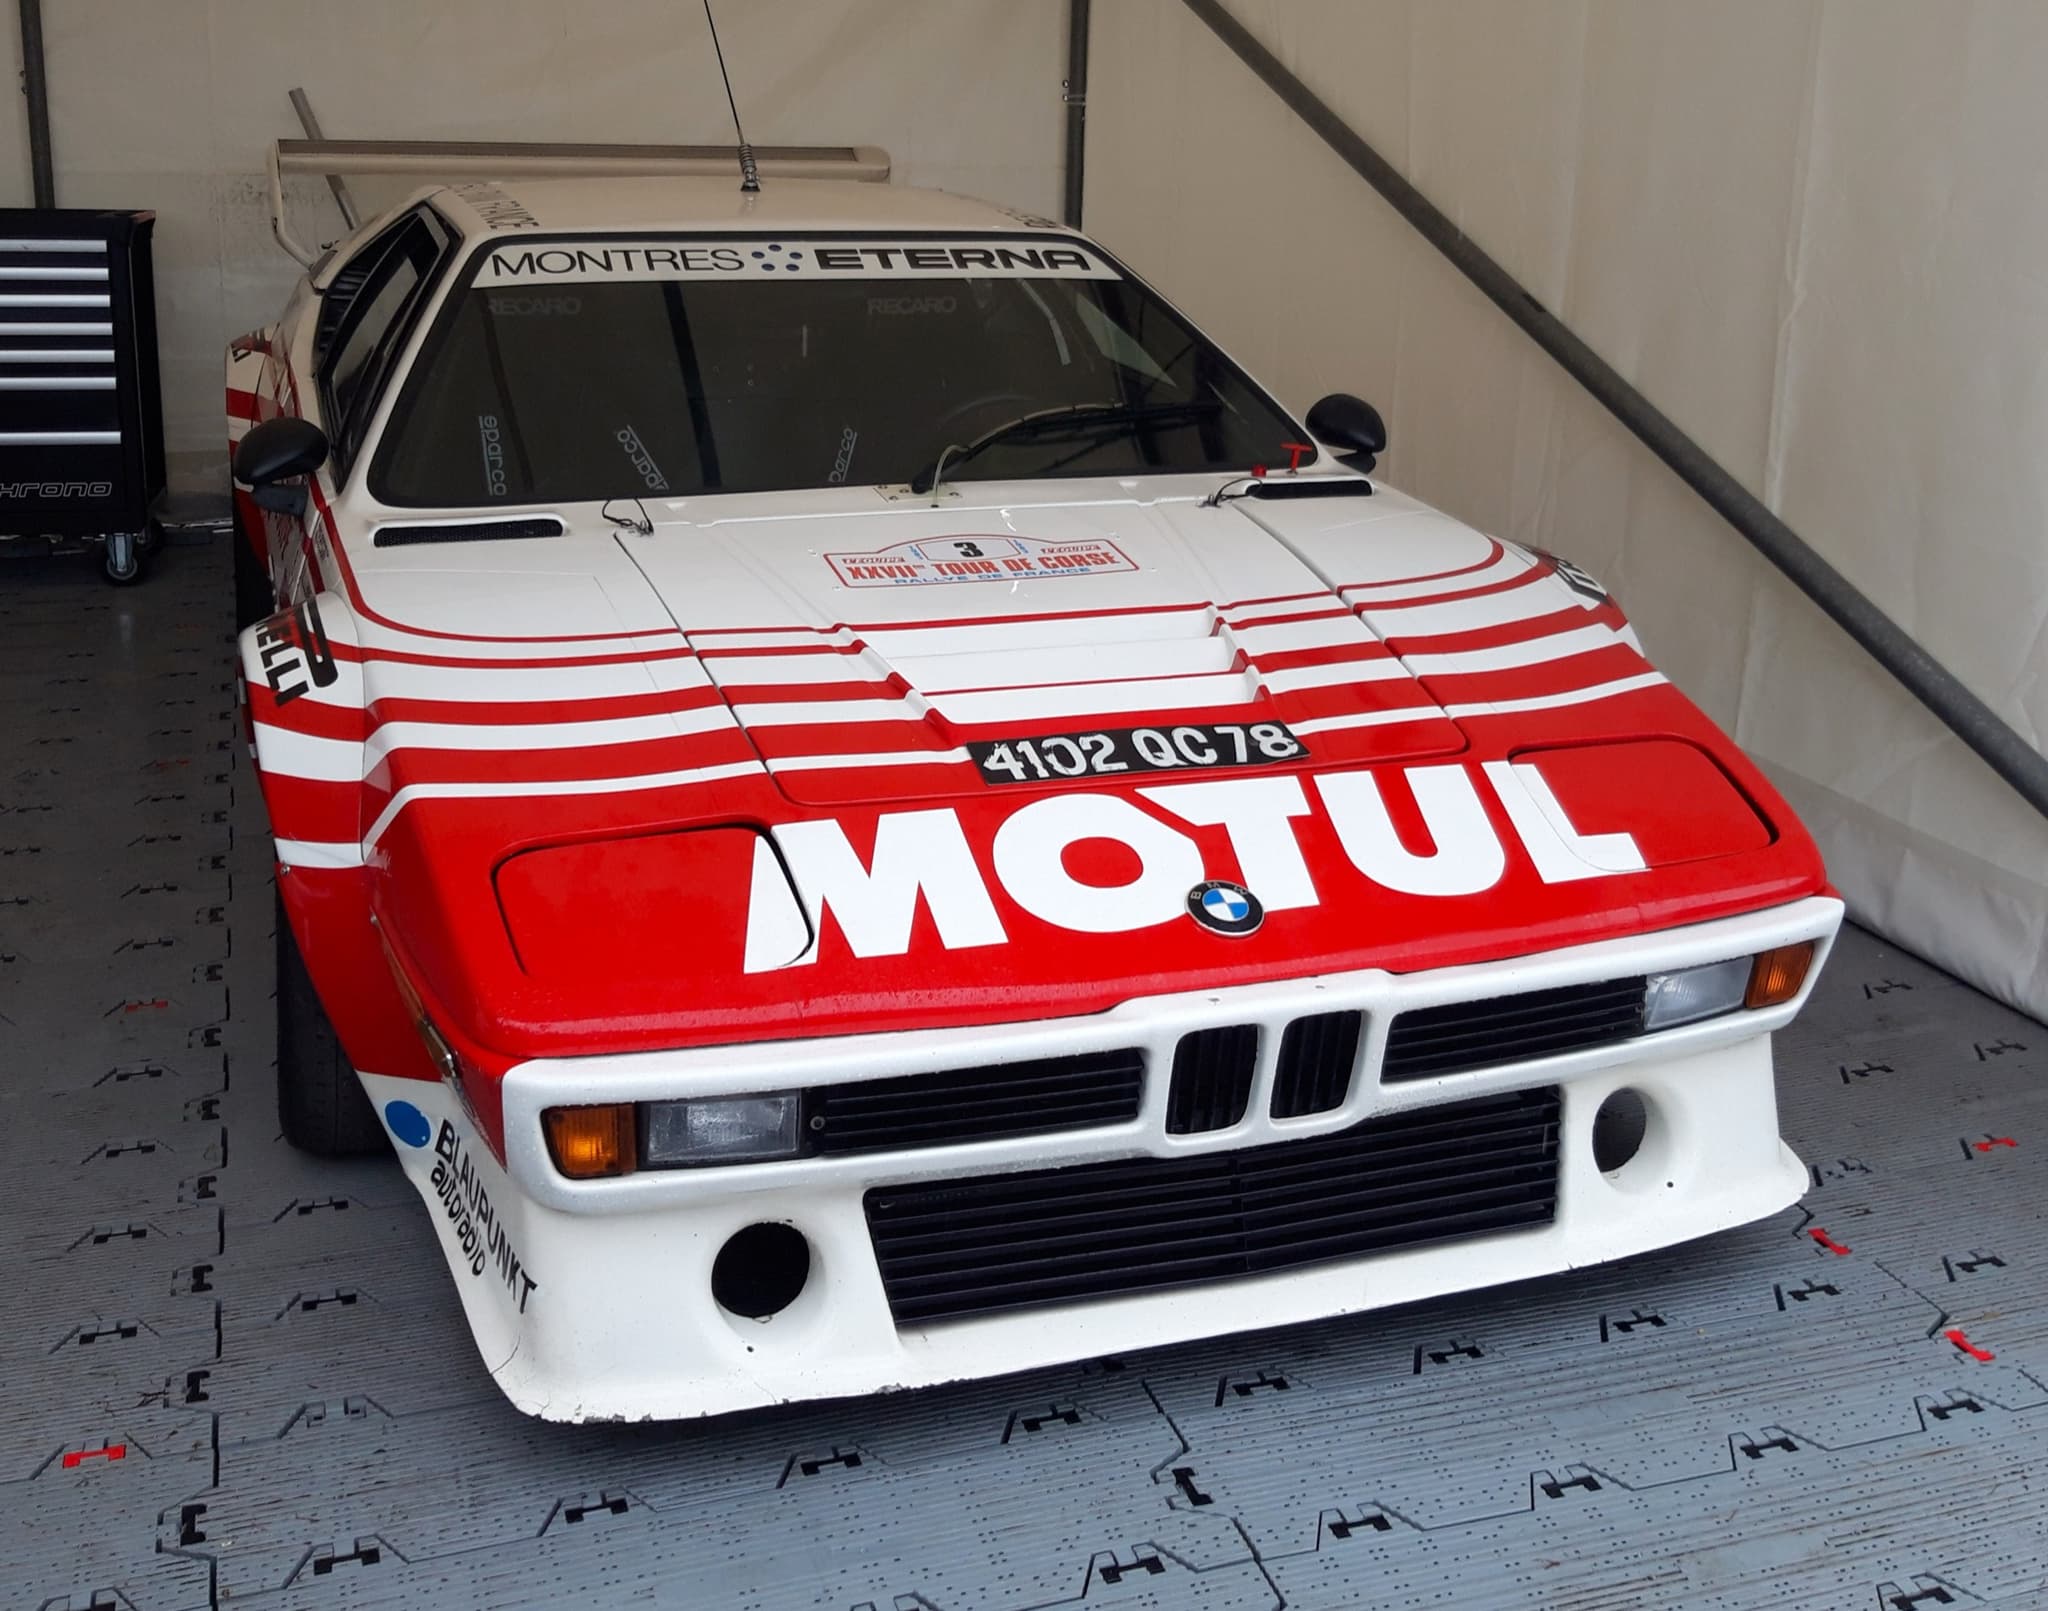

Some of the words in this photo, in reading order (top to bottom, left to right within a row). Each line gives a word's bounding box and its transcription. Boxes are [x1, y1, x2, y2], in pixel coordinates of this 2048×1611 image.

[491, 248, 745, 277] MONTRES
[814, 248, 1092, 271] ETERNA
[931, 558, 1001, 577] TOUR
[1000, 556, 1037, 573] DE
[1037, 551, 1121, 571] CORSE
[952, 541, 985, 558] 3
[894, 573, 969, 585] RALLYE
[974, 572, 1003, 580] DE
[1013, 566, 1092, 578] FRANCE
[983, 734, 1129, 781] 4102
[743, 760, 1651, 975] MOTUL
[430, 1160, 486, 1276] autoradio
[435, 1118, 539, 1315] BLAUPUNKT
